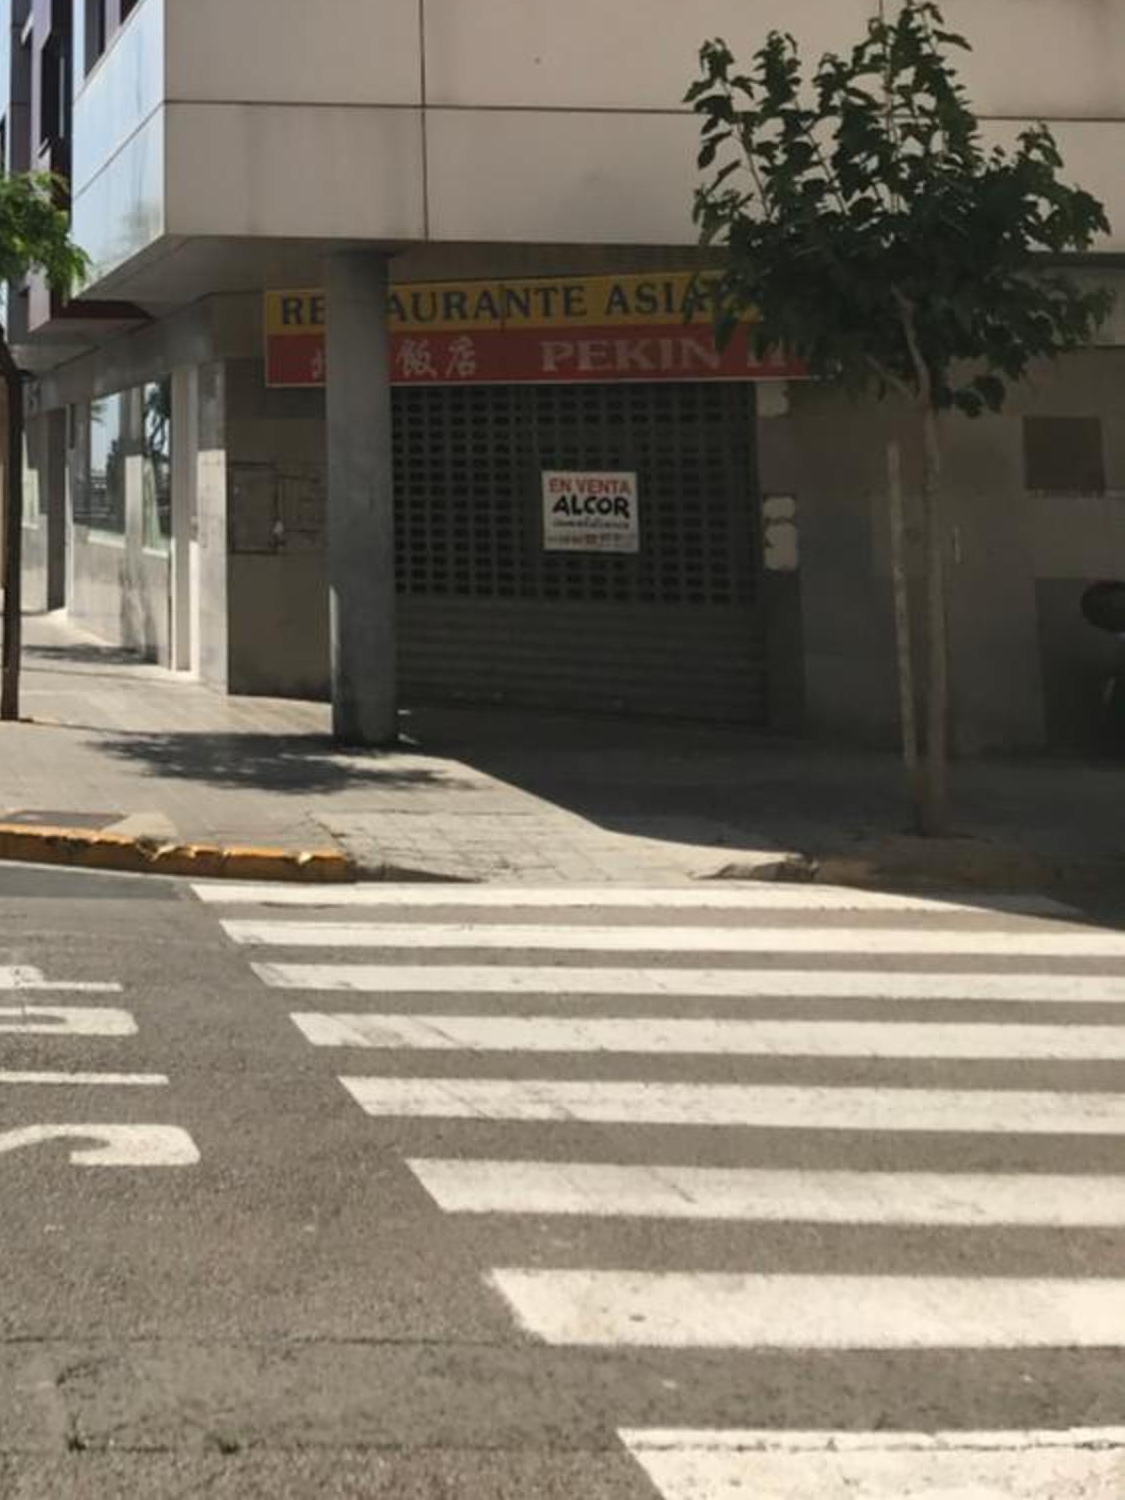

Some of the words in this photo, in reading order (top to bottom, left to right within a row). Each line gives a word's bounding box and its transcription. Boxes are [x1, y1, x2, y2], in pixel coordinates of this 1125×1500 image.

[281, 284, 587, 326] REAURANTE
[539, 336, 723, 373] PEKIN
[549, 477, 572, 494] EN
[575, 477, 632, 495] VENTA
[552, 493, 630, 519] ALCOR
